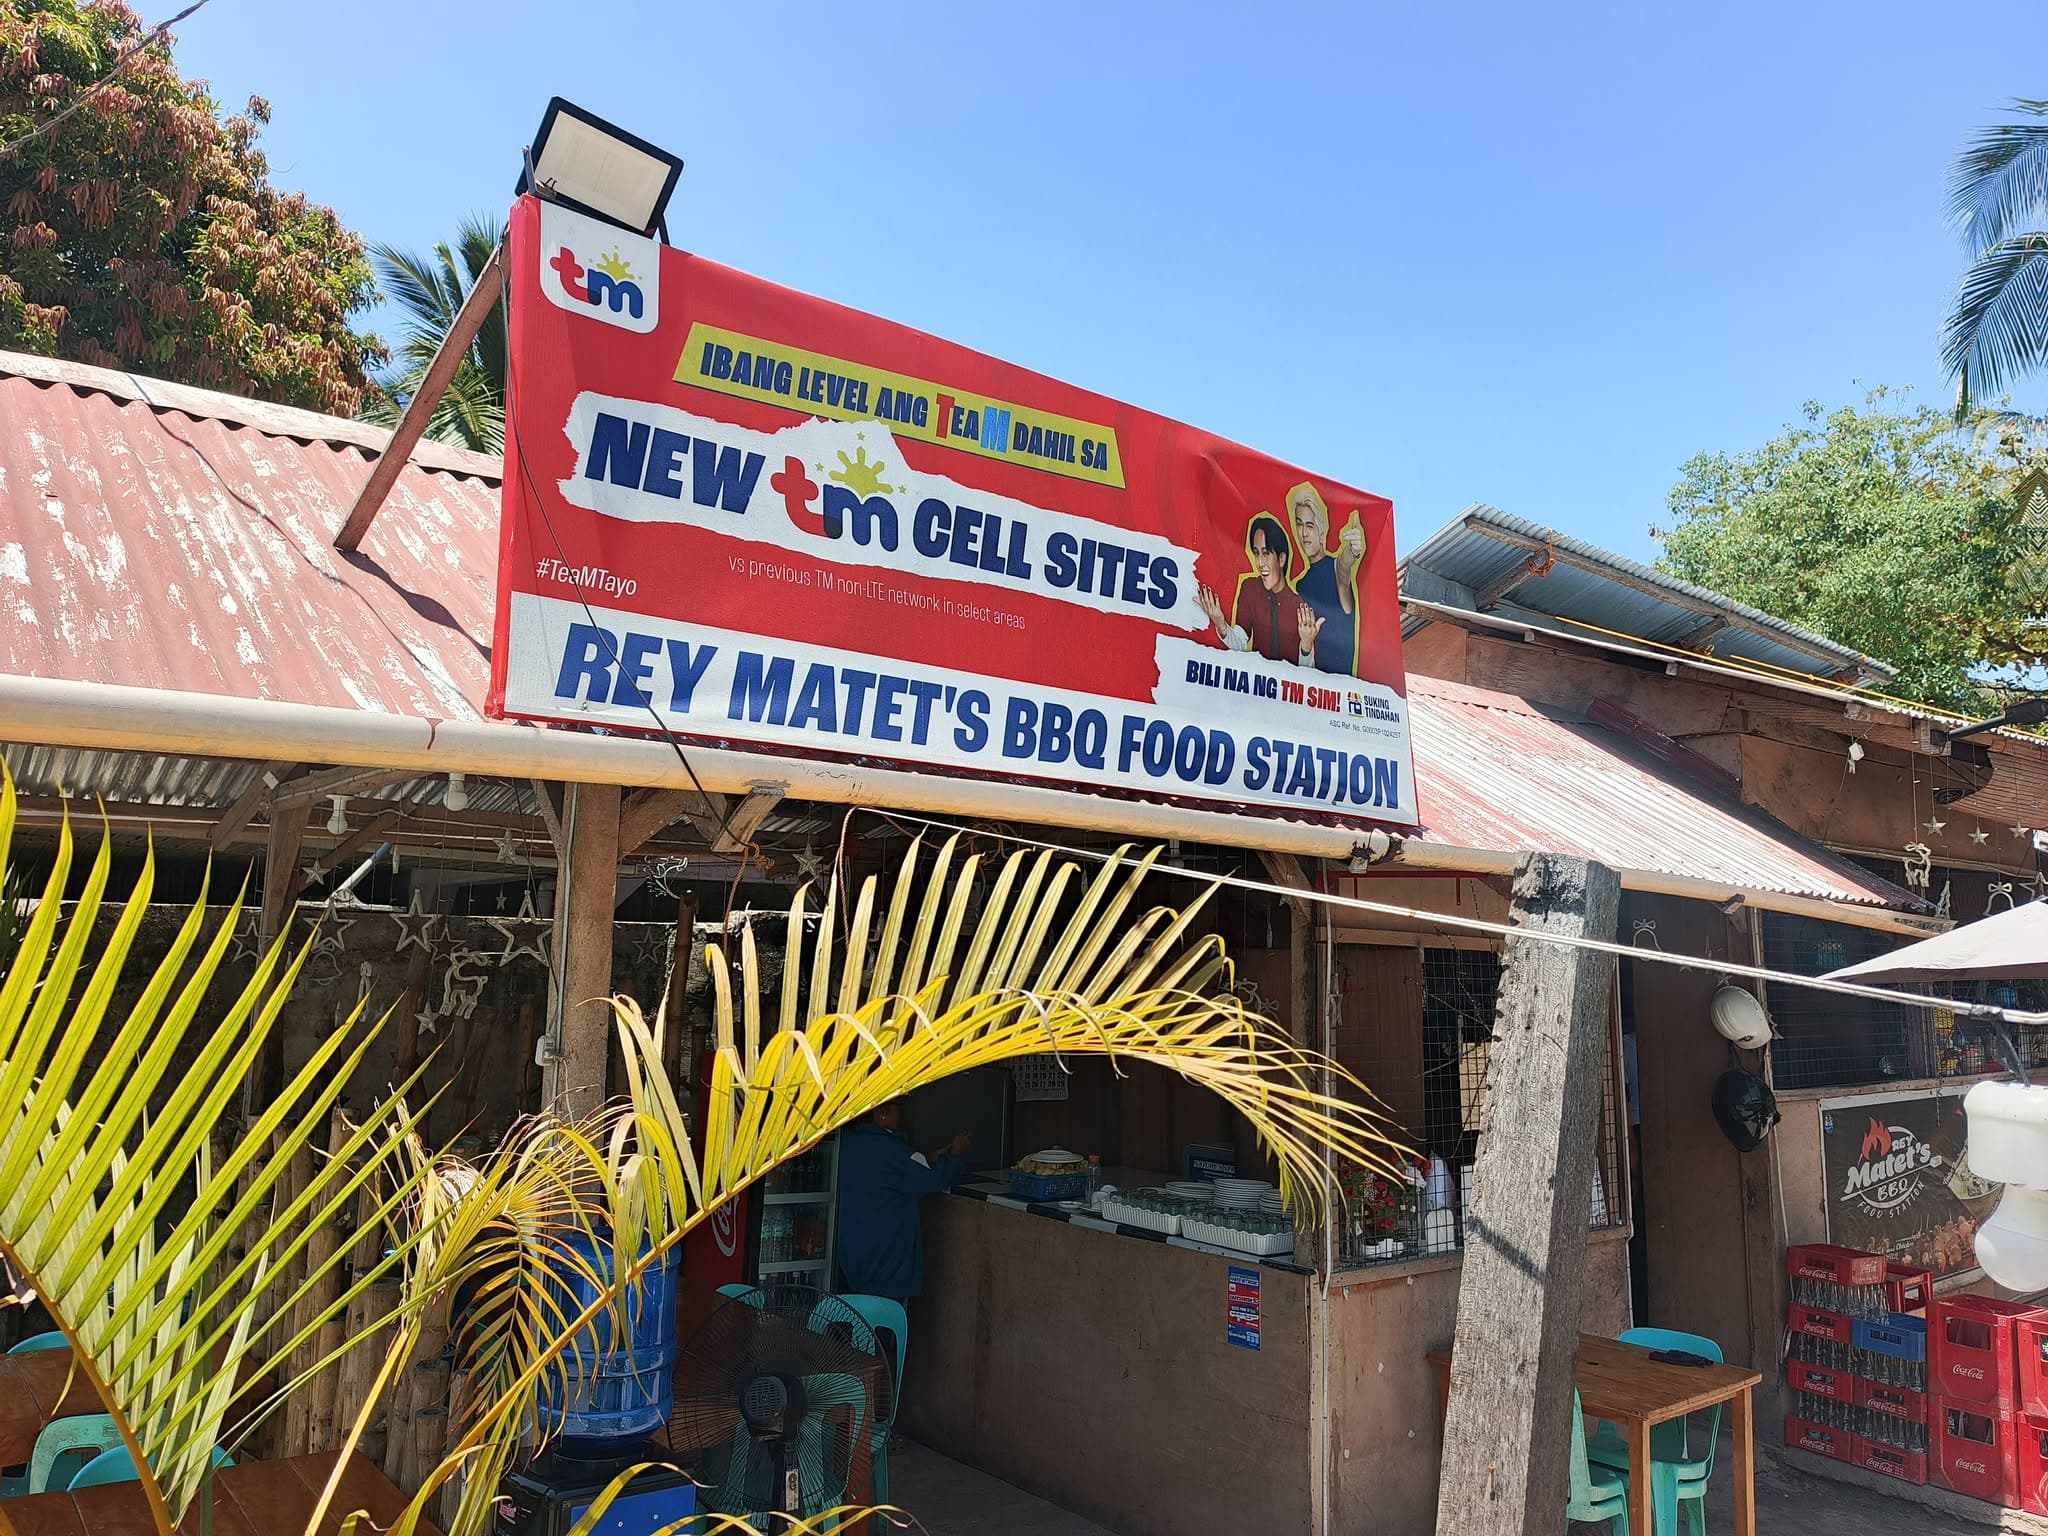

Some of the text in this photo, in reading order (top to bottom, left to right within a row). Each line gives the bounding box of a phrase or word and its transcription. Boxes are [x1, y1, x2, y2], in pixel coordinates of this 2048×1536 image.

[549, 246, 644, 319] tm
[700, 342, 793, 394] IBANG
[797, 366, 869, 412] LEVEL
[874, 387, 929, 427] ANG
[1012, 421, 1076, 464] DAHIL
[1080, 438, 1108, 471] SA
[584, 412, 1178, 610] NEW tm CELL SITES
[536, 558, 637, 598] #TeaMTayo
[728, 556, 1026, 630] vs previous TM non-LTE network in select areas
[1186, 659, 1341, 713] BILI NA NG TM SIM!
[1363, 695, 1389, 710] SUKING
[554, 622, 1399, 810] REY MATET'S BBQ FOOD STATION
[1364, 707, 1400, 723] TINDAHAN
[1892, 1135, 1913, 1152] REY
[1844, 1142, 1931, 1194] Matet's
[1857, 1180, 1925, 1219] FOOD STATION
[1877, 1178, 1908, 1201] BBQ
[1953, 1364, 1985, 1380] Coca-Cola
[1955, 1458, 1986, 1475] Coca-Cola
